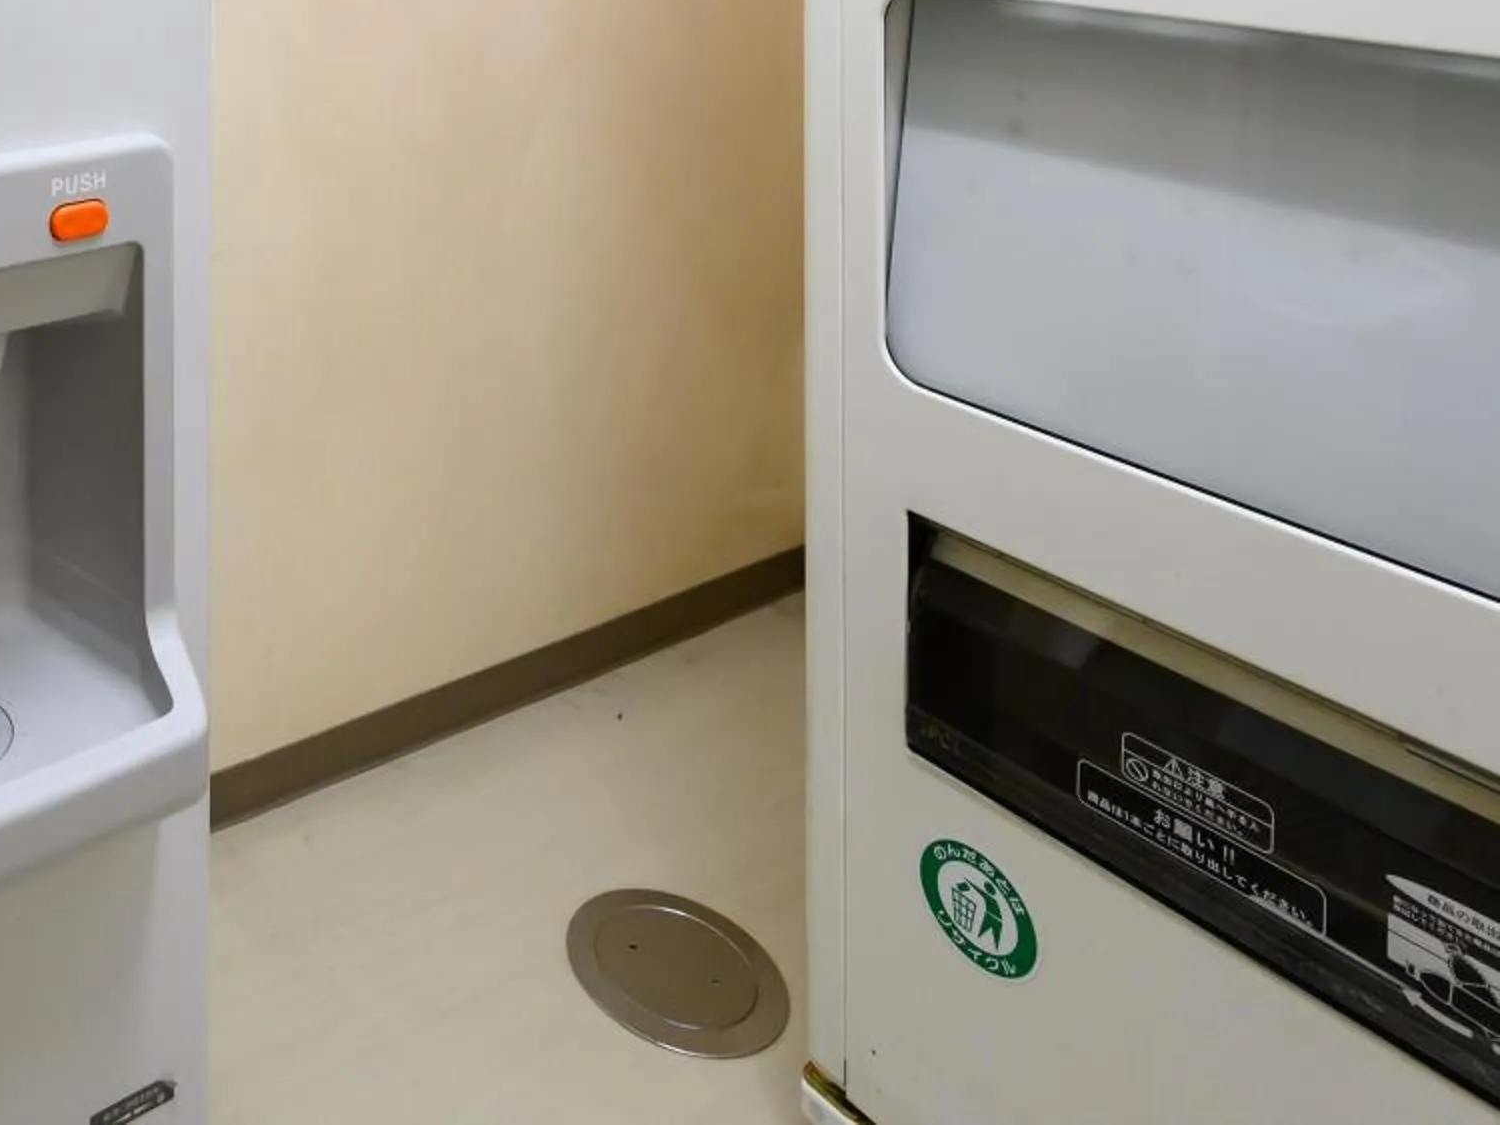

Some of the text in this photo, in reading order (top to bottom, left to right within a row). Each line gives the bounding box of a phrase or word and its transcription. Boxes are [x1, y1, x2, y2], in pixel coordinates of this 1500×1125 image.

[51, 170, 106, 197] PUSH
[937, 909, 1017, 976] リサイクル
